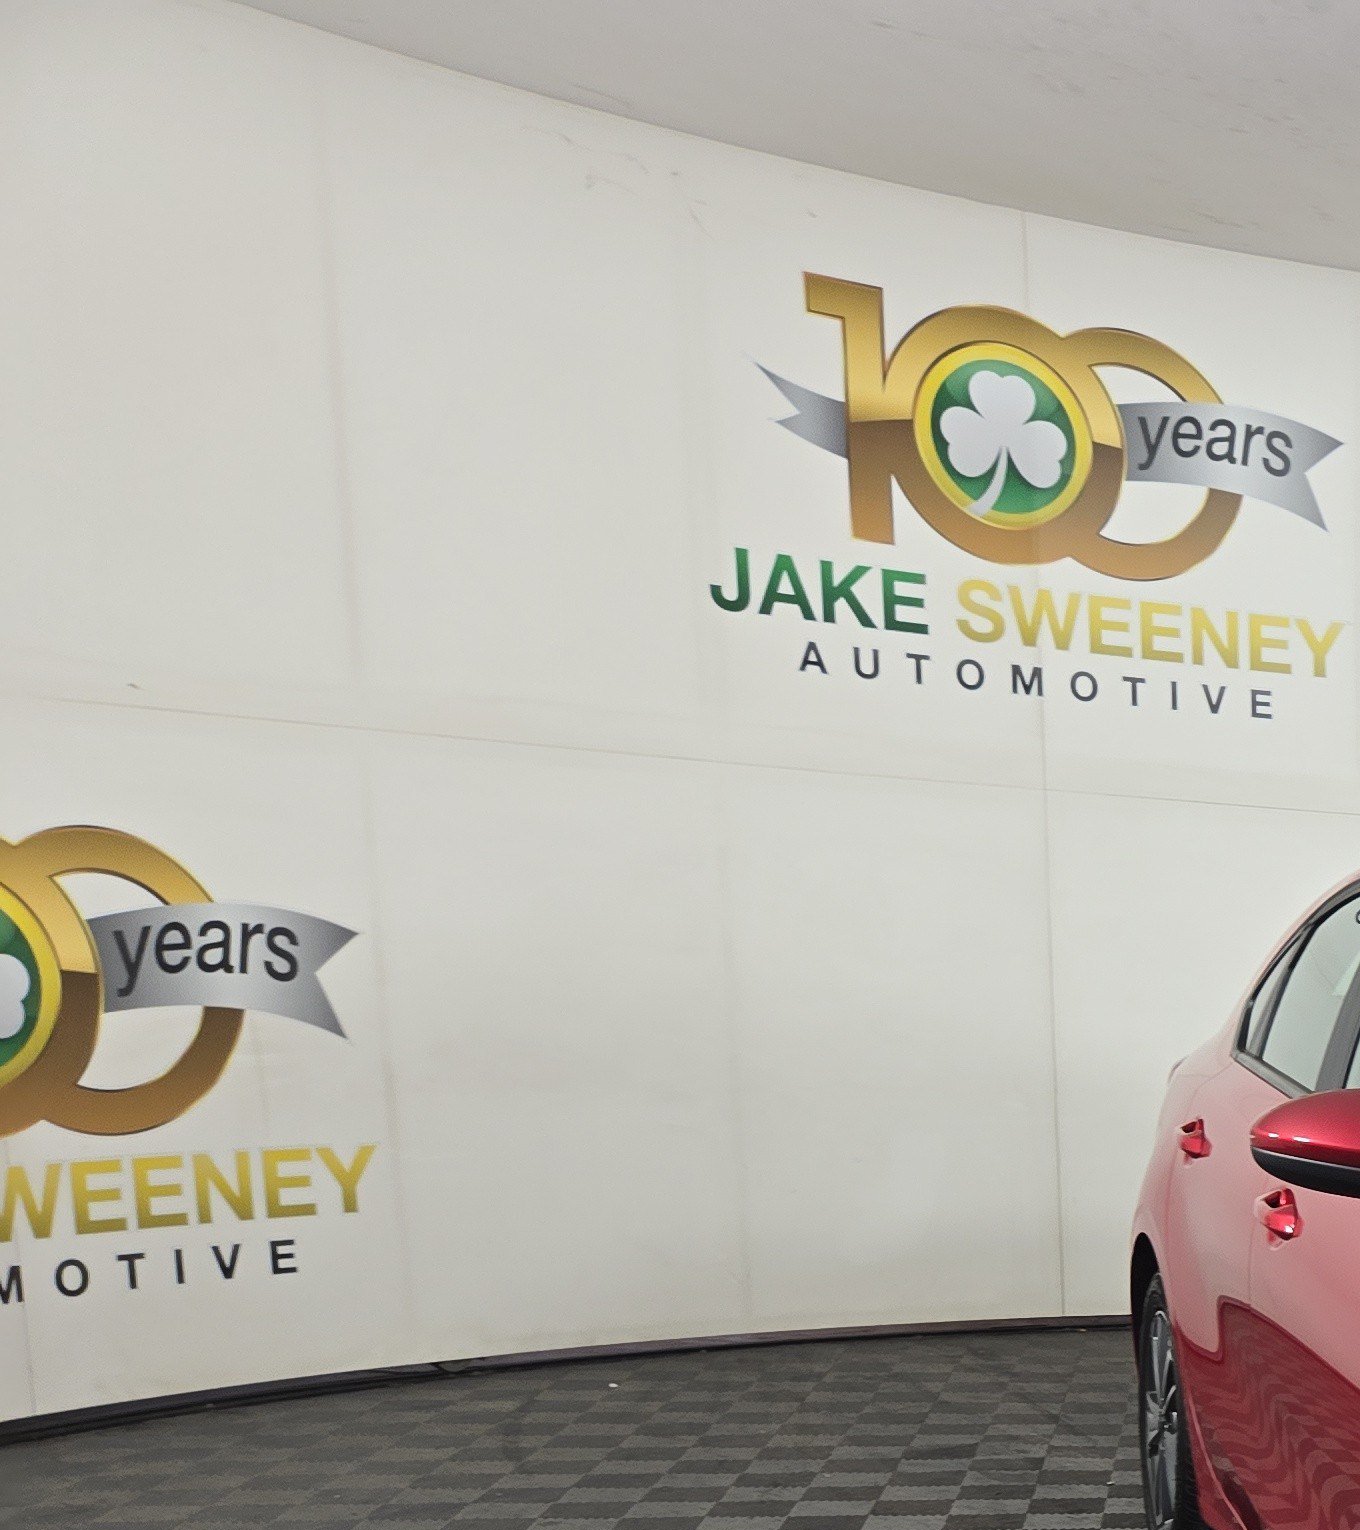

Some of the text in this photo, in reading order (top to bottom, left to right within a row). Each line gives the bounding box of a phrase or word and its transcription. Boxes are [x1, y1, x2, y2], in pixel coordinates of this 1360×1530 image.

[803, 271, 1293, 581] 100 years
[709, 547, 1345, 678] JAKE SWEENEY
[799, 641, 1273, 720] AUTOMOTIVE
[112, 918, 300, 998] years
